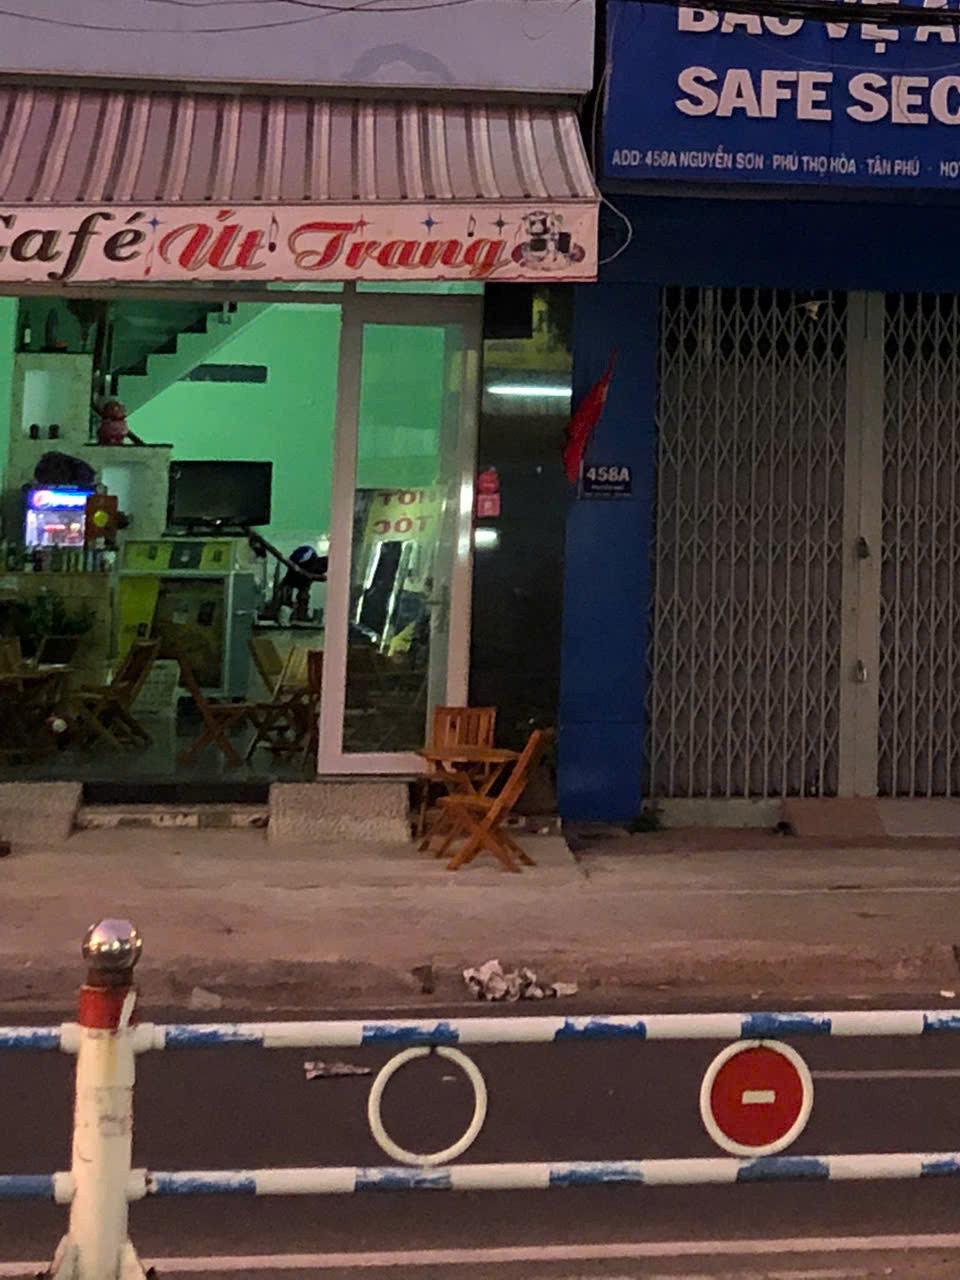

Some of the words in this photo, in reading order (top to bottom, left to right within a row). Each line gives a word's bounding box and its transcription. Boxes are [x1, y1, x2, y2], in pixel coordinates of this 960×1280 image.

[675, 66, 834, 121] SAFE
[645, 150, 678, 168] 458A
[679, 145, 732, 169] NGUYỄN
[158, 209, 266, 271] Út
[288, 220, 511, 277] Trang
[586, 466, 630, 482] 458A
